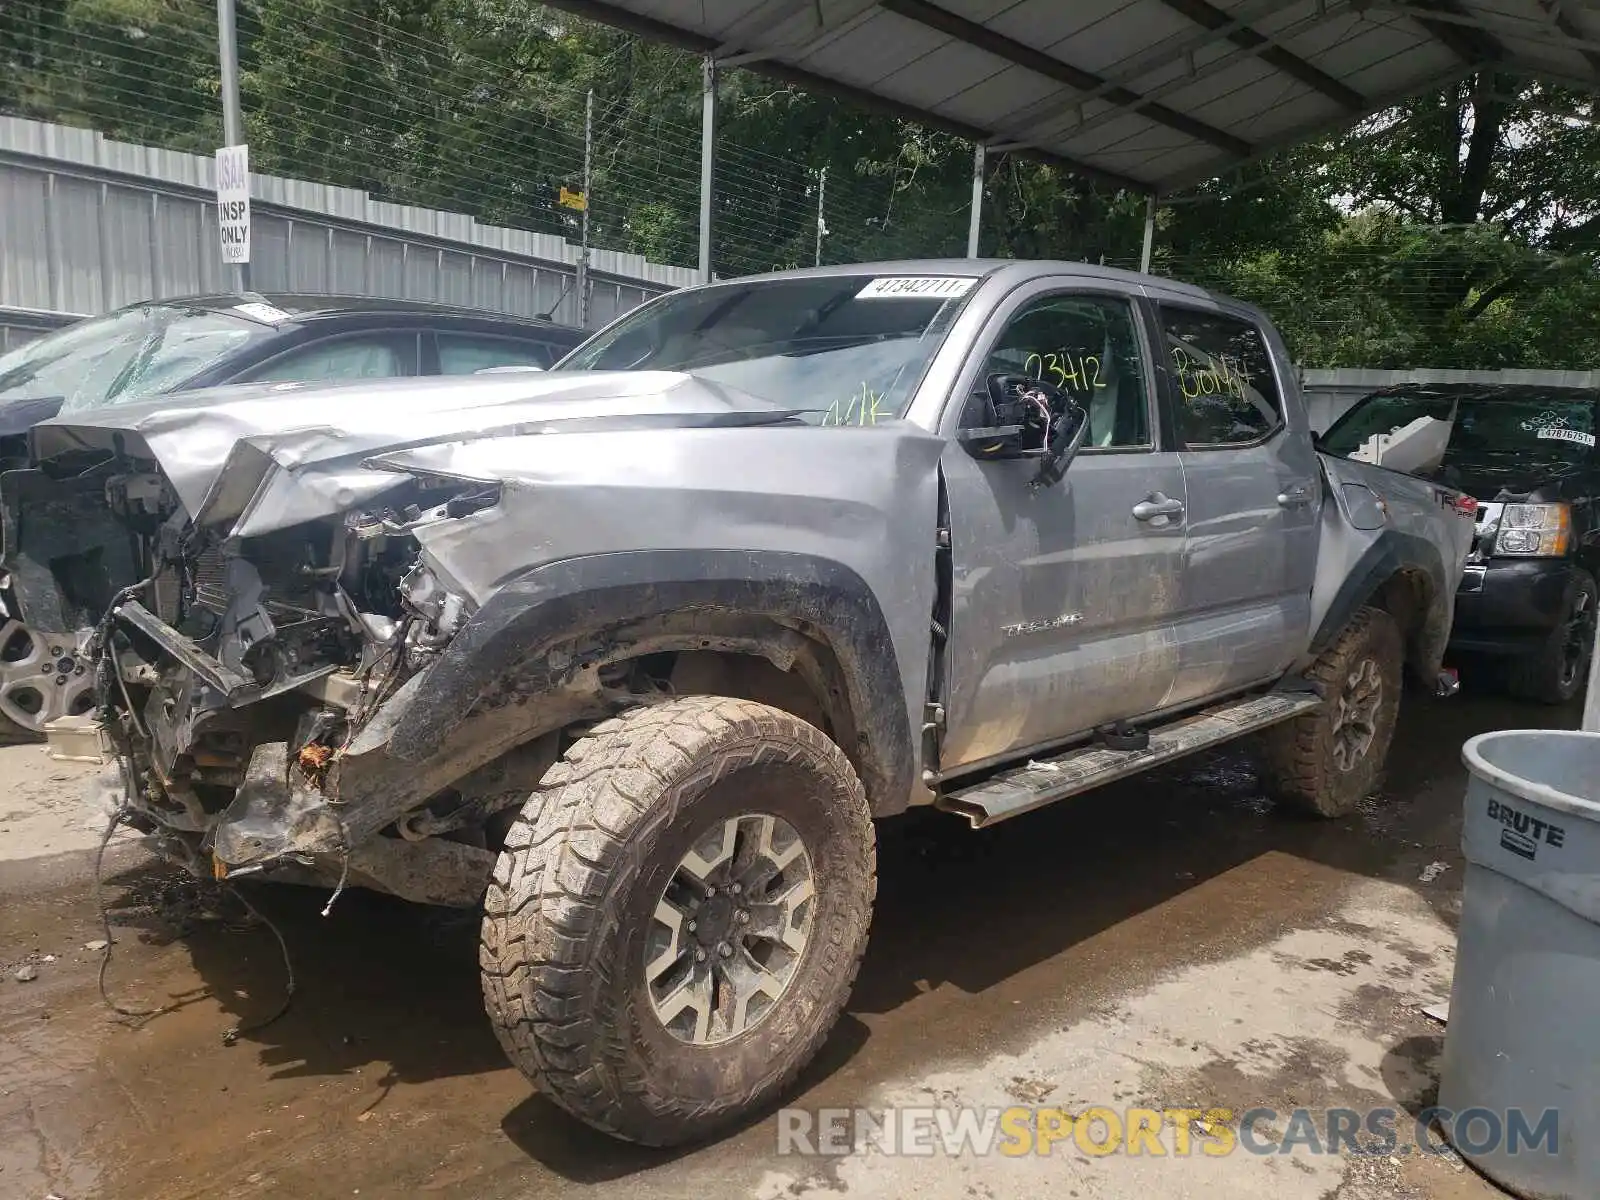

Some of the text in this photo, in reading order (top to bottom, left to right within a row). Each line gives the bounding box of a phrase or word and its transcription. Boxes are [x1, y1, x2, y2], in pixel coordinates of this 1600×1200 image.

[219, 200, 246, 221] INSP
[221, 225, 248, 244] ONLY
[1487, 797, 1566, 849] BRUTE
